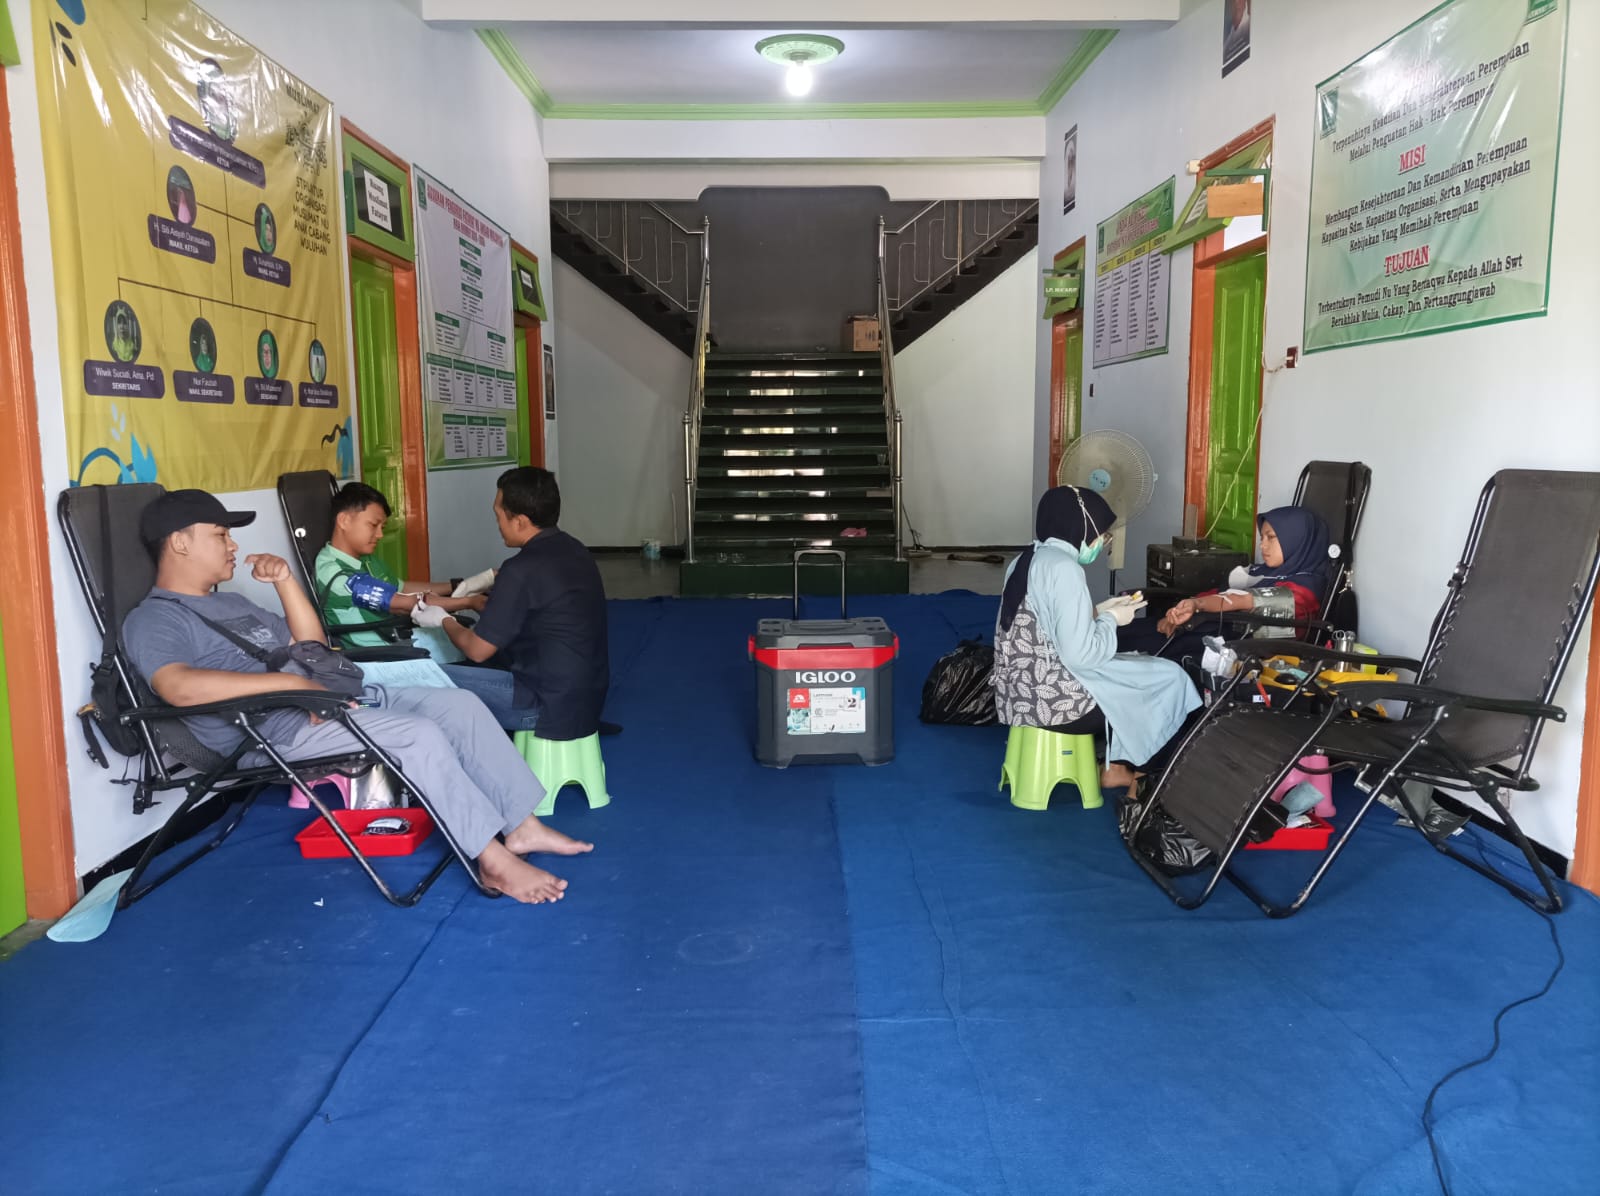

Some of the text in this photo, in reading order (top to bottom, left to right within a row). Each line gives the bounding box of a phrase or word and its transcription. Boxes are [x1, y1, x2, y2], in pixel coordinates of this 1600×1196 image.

[1372, 126, 1407, 151] Penguatan
[1408, 115, 1424, 132] Hak
[1430, 104, 1447, 122] Hak
[1325, 136, 1528, 225] Membangun Kesejahteraan Dan Kemandirian Perempuan
[1398, 144, 1426, 173] MISI
[1321, 227, 1348, 245] Kapasitas
[1365, 208, 1397, 229] Kapasitas
[1398, 191, 1438, 217] Organisasi,
[1439, 184, 1461, 202] Serta
[1463, 159, 1531, 194] Mengupayakan
[1349, 200, 1479, 252] Kebijakan Yang Memihak Perempuan
[1384, 245, 1429, 274] TUJUAN
[1318, 297, 1356, 314] Terbentuknya
[1357, 287, 1381, 304] Pemudi
[1382, 286, 1392, 299] Nu
[1393, 283, 1410, 297] Yang
[1447, 264, 1478, 285] Kepada
[1480, 258, 1503, 276] Allah
[1505, 253, 1523, 270] Swt
[1331, 312, 1360, 327] Berakhlak
[1382, 304, 1406, 318] Cakap,
[1407, 300, 1422, 313] Dan
[1423, 282, 1496, 309] Bertanggungjawab
[795, 670, 857, 684] IGLOO
[847, 697, 857, 708] 2
